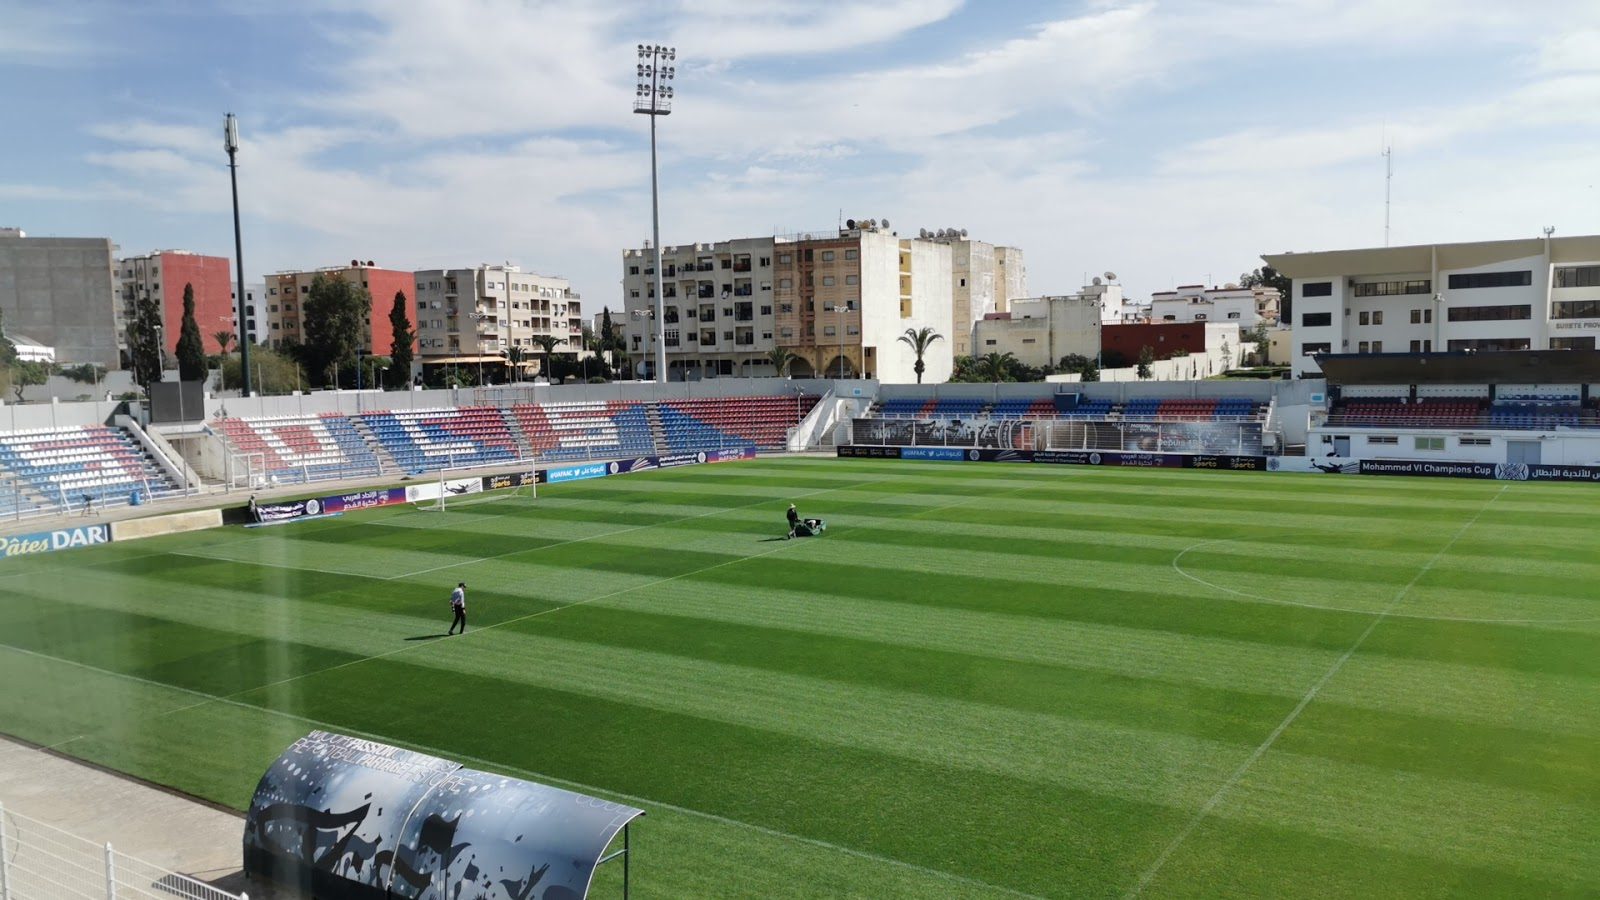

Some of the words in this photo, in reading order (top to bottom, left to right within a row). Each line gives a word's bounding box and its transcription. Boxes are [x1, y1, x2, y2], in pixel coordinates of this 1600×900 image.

[1362, 462, 1412, 472] Mohammed
[1413, 463, 1422, 472] VI
[1424, 464, 1472, 475] Champions
[1474, 465, 1491, 476] Cup
[1532, 468, 1561, 478] الأبطال
[1562, 469, 1590, 478] للأندية
[51, 524, 108, 550] DARI
